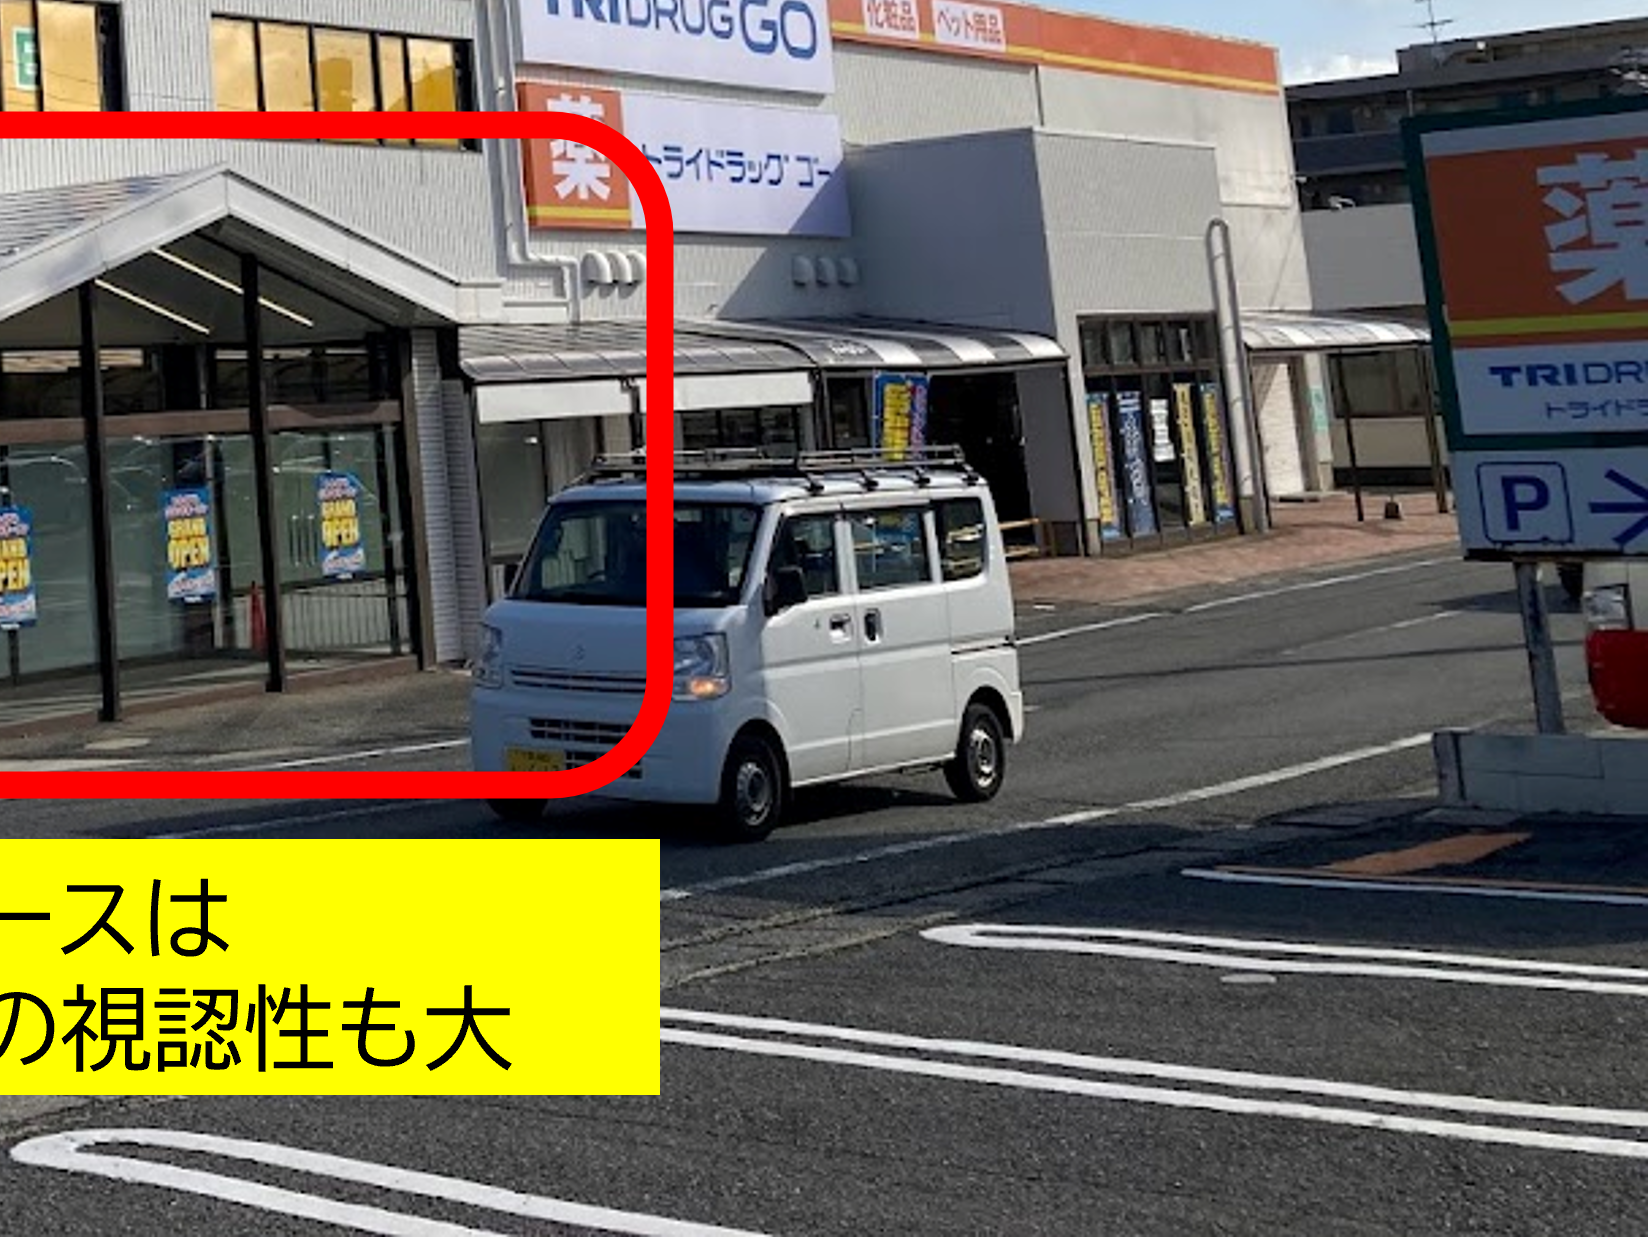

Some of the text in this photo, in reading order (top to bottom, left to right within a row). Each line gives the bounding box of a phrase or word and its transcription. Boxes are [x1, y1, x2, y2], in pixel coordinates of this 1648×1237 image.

[937, 6, 1002, 44] ペット用品
[1489, 361, 1648, 387] TRIDR
[1500, 476, 1549, 531] P
